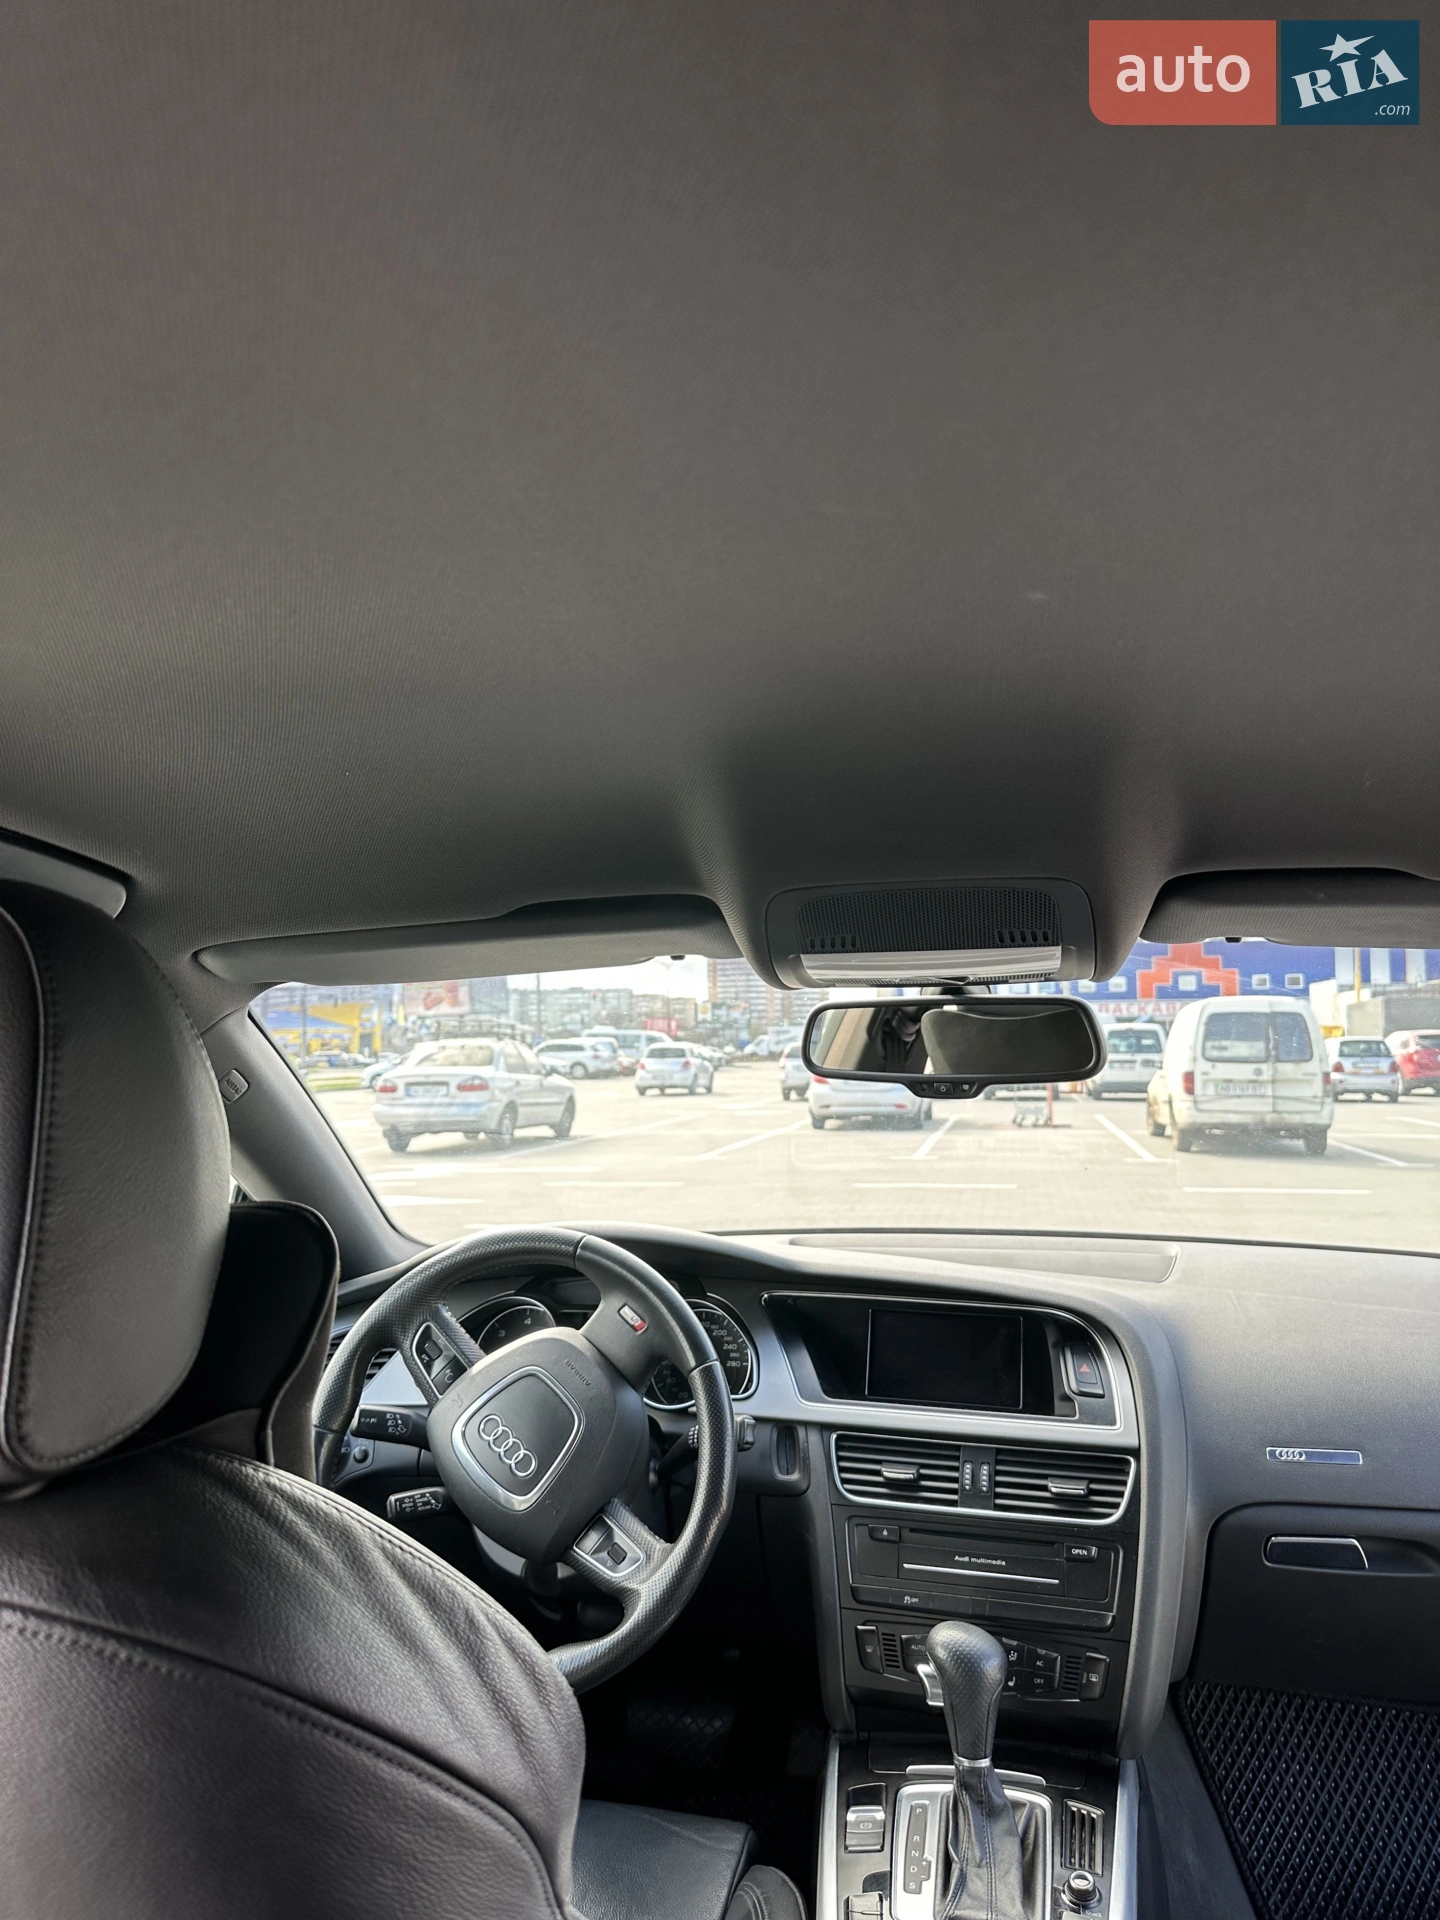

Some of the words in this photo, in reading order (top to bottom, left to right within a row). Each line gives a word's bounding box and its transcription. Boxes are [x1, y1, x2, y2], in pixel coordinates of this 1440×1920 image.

[225, 1079, 241, 1095] AIRBAG
[524, 1317, 532, 1325] 4
[1071, 1548, 1088, 1556] OPEN
[954, 1554, 969, 1562] Audi
[970, 1557, 1006, 1566] multimedia
